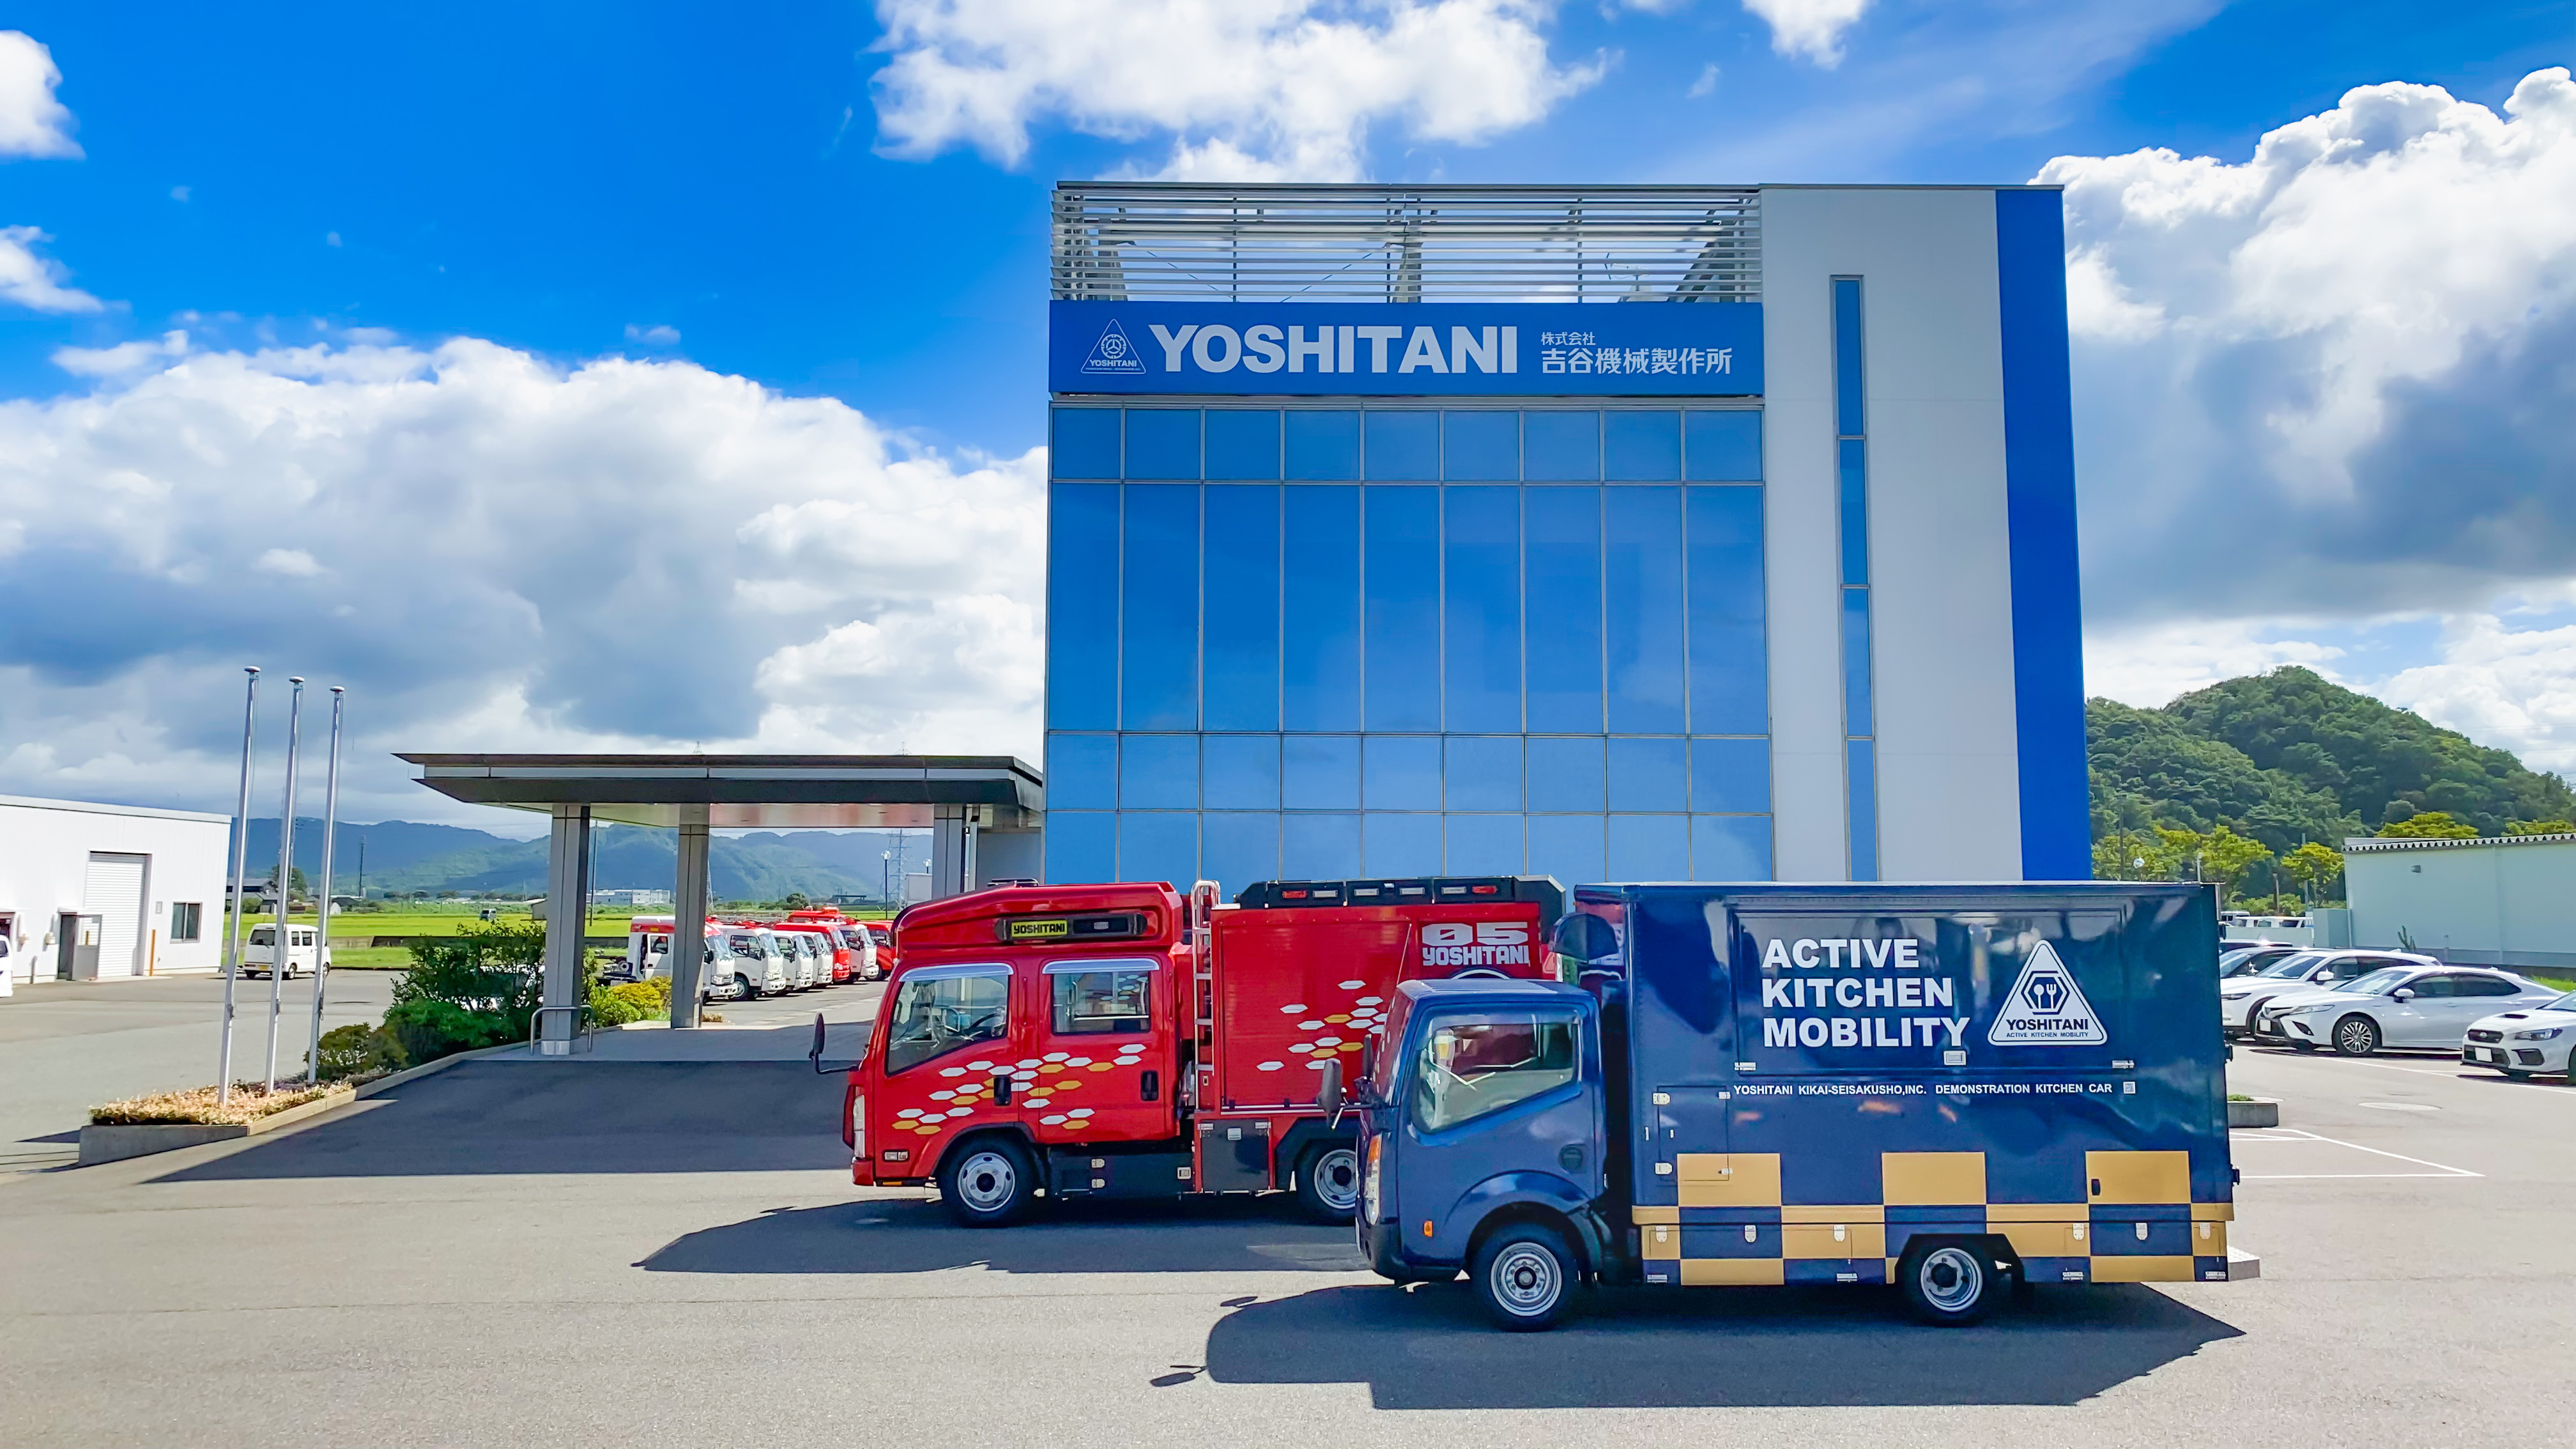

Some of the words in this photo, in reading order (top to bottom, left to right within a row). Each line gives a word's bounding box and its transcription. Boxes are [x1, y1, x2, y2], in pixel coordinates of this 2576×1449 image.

[1148, 325, 1517, 374] YOSHITANI
[1540, 332, 1596, 346] 株式会社
[1089, 359, 1137, 367] YOSHITANI
[1540, 347, 1733, 374] 吉谷機械製作所
[1013, 923, 1065, 935] YOSHITANI
[1422, 921, 1528, 947] 05
[1422, 946, 1529, 966] YOSHITANI
[1762, 939, 1919, 969] ACTIVE
[1762, 977, 1953, 1008] KITCHEN
[1763, 1017, 1970, 1047] MOBILITY
[2005, 1018, 2089, 1031] YOSHITANI
[1733, 1085, 1793, 1095] YOSHITANI
[1798, 1085, 1927, 1096] KIKAI-SEISAKUSHO,INC.
[1935, 1084, 2030, 1094] DEMONSTRATION
[2035, 1084, 2083, 1093] KITCHEN
[2089, 1084, 2113, 1093] CAR
